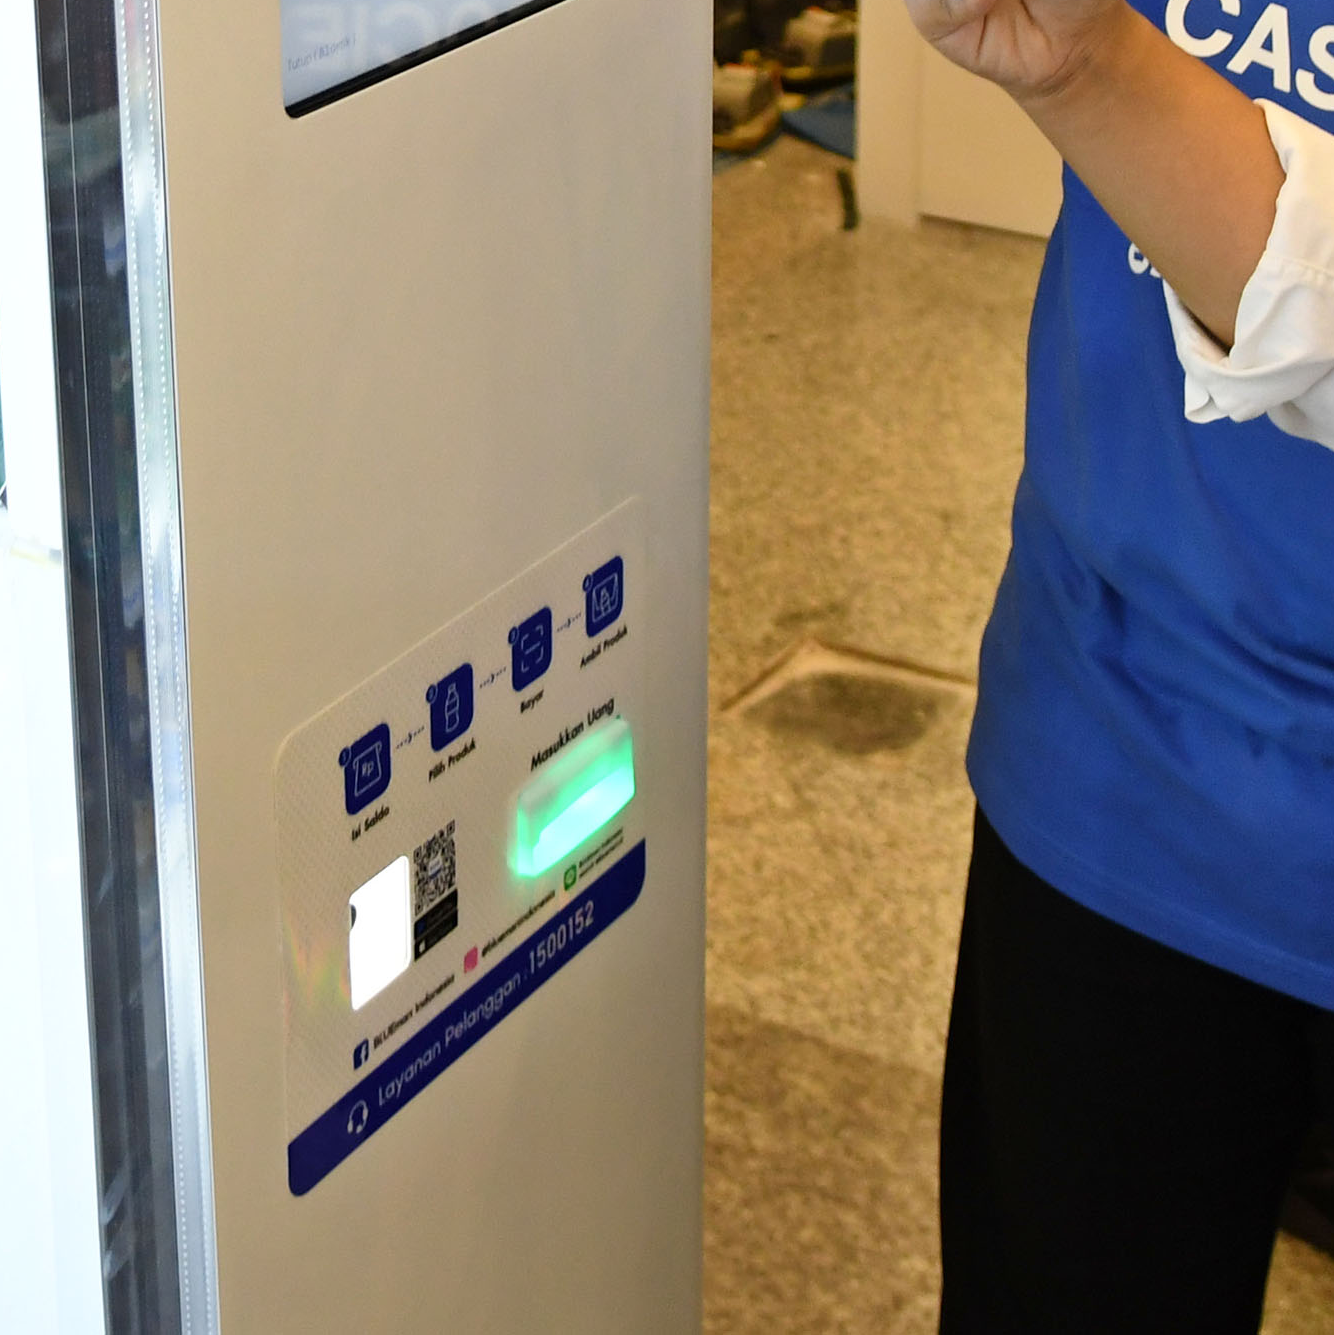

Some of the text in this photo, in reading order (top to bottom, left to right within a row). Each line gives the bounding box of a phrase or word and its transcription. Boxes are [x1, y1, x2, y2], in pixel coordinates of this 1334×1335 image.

[530, 698, 614, 772] Masukkan Uang
[364, 804, 390, 834] Saldo
[378, 900, 595, 1107] Layanan Pelanggan 1500152
